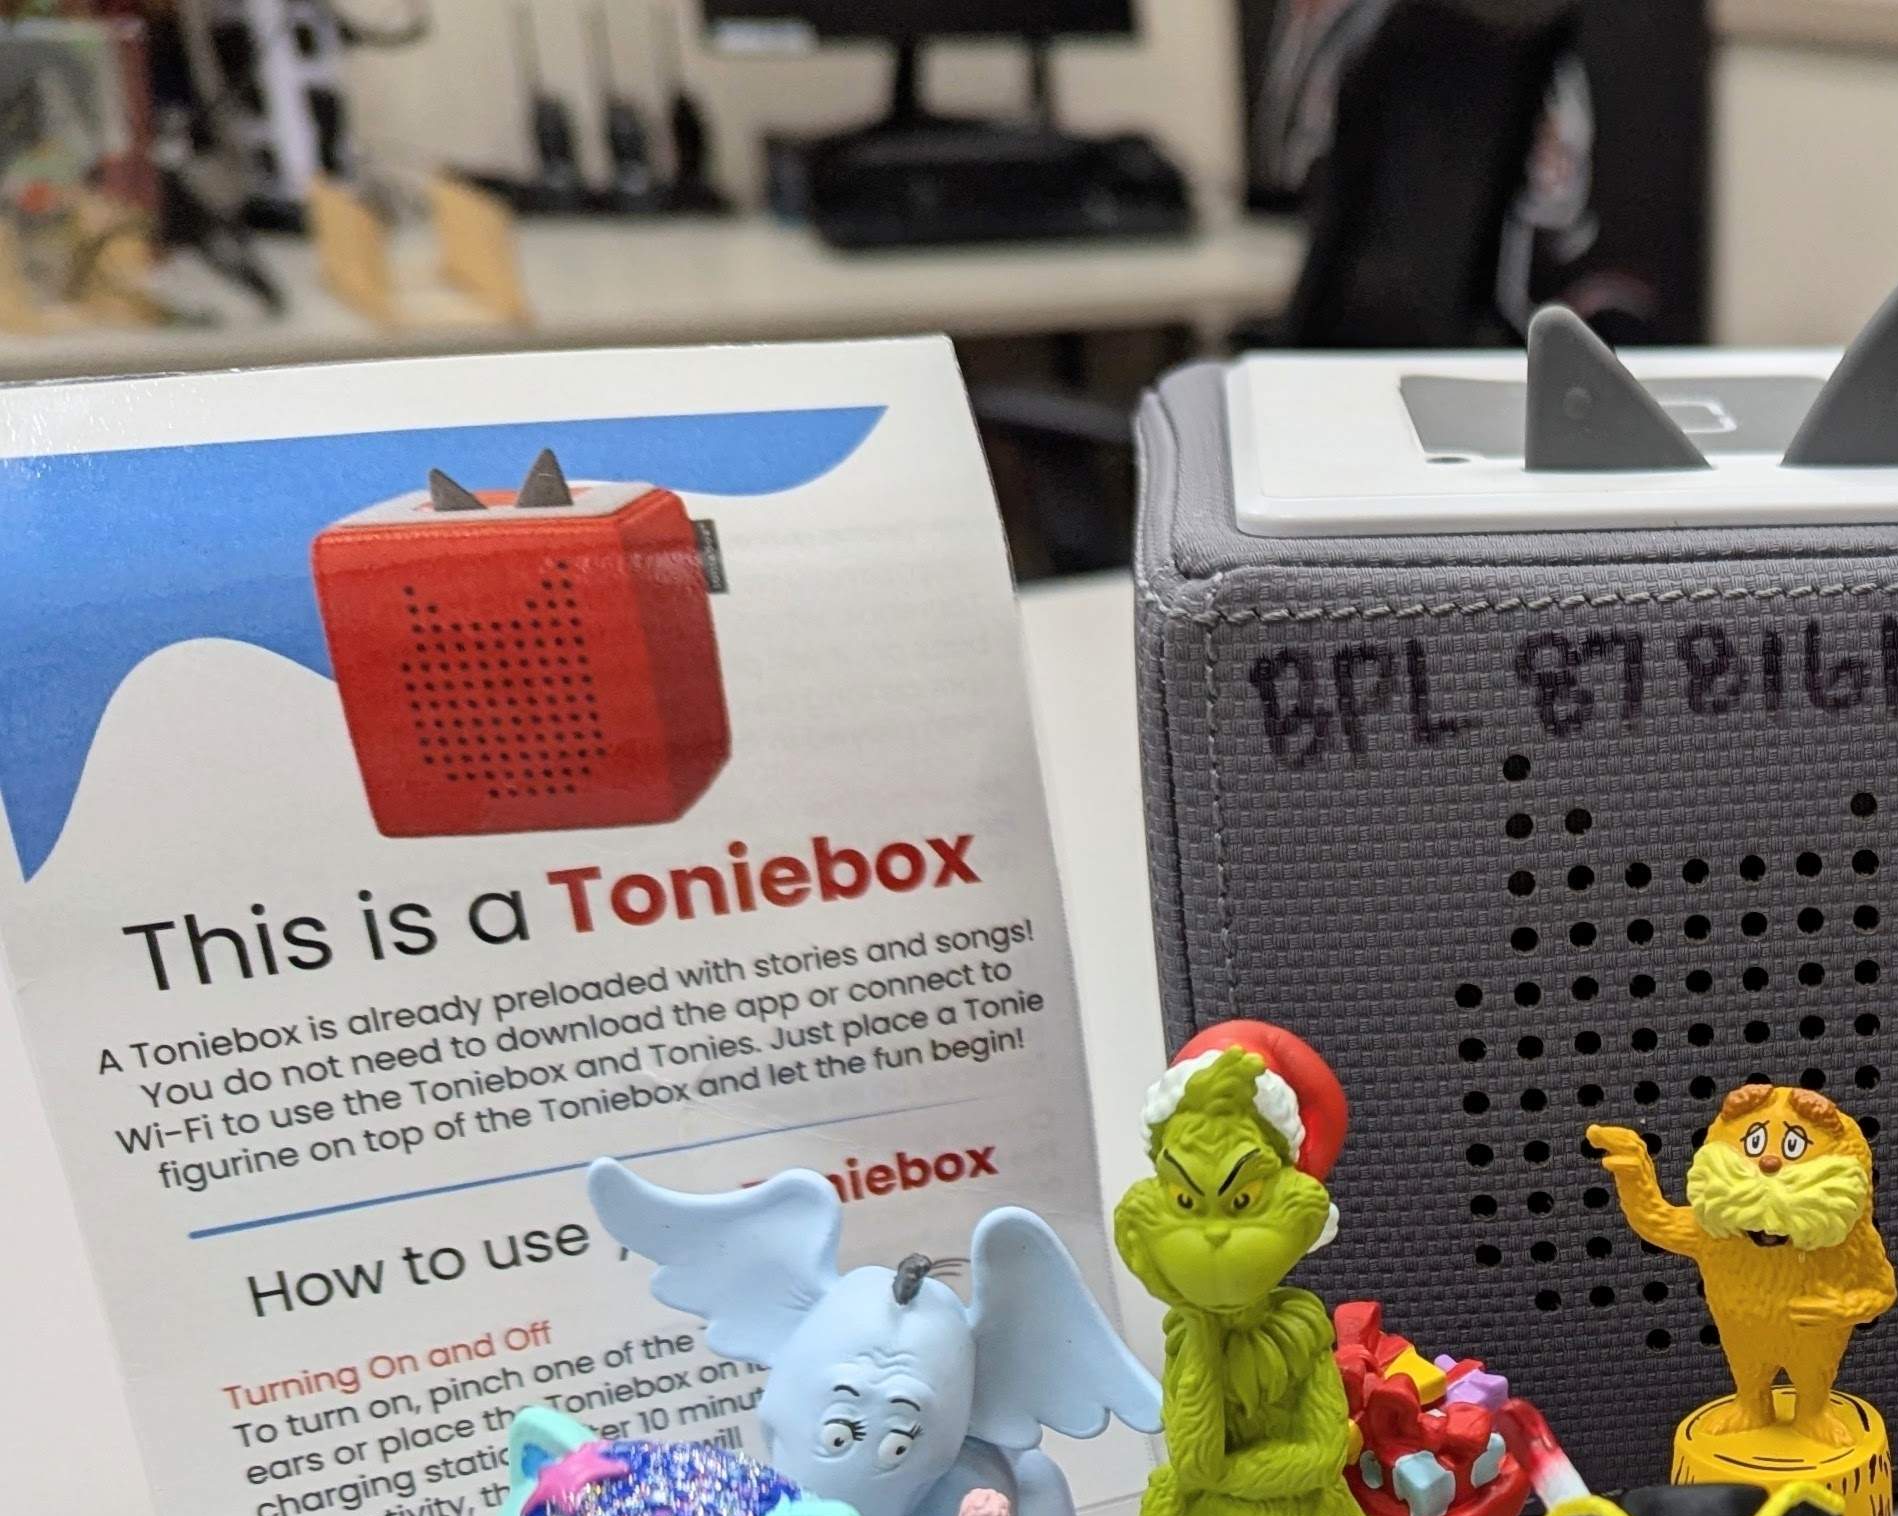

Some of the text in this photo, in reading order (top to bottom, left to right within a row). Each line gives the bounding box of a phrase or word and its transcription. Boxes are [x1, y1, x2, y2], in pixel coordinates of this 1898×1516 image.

[1250, 637, 1480, 767] BPL
[122, 835, 982, 990] This is a Toniebox
[98, 920, 1035, 1075] A Toniebox is already preloaded with stories and songs!
[140, 959, 1012, 1110] You do not need to download the app or connect to
[116, 990, 1044, 1154] Wi-Fi to use the Toniebox and Tonies. Just place a Tonie
[158, 1028, 1024, 1193] figurine on top of the Toniebox and let the fun begin!
[742, 1147, 998, 1203] niebox
[247, 1222, 590, 1317] How to use
[222, 1321, 553, 1410] Turning On and Off
[233, 1334, 695, 1447] To turn on, pinch one of the
[246, 1451, 325, 1484] ears
[333, 1440, 368, 1465] or
[378, 1419, 475, 1463] place
[482, 1405, 524, 1431] th
[545, 1370, 692, 1414] Toniebox
[699, 1361, 739, 1384] on
[637, 1407, 670, 1433] 10
[480, 1482, 511, 1507] th
